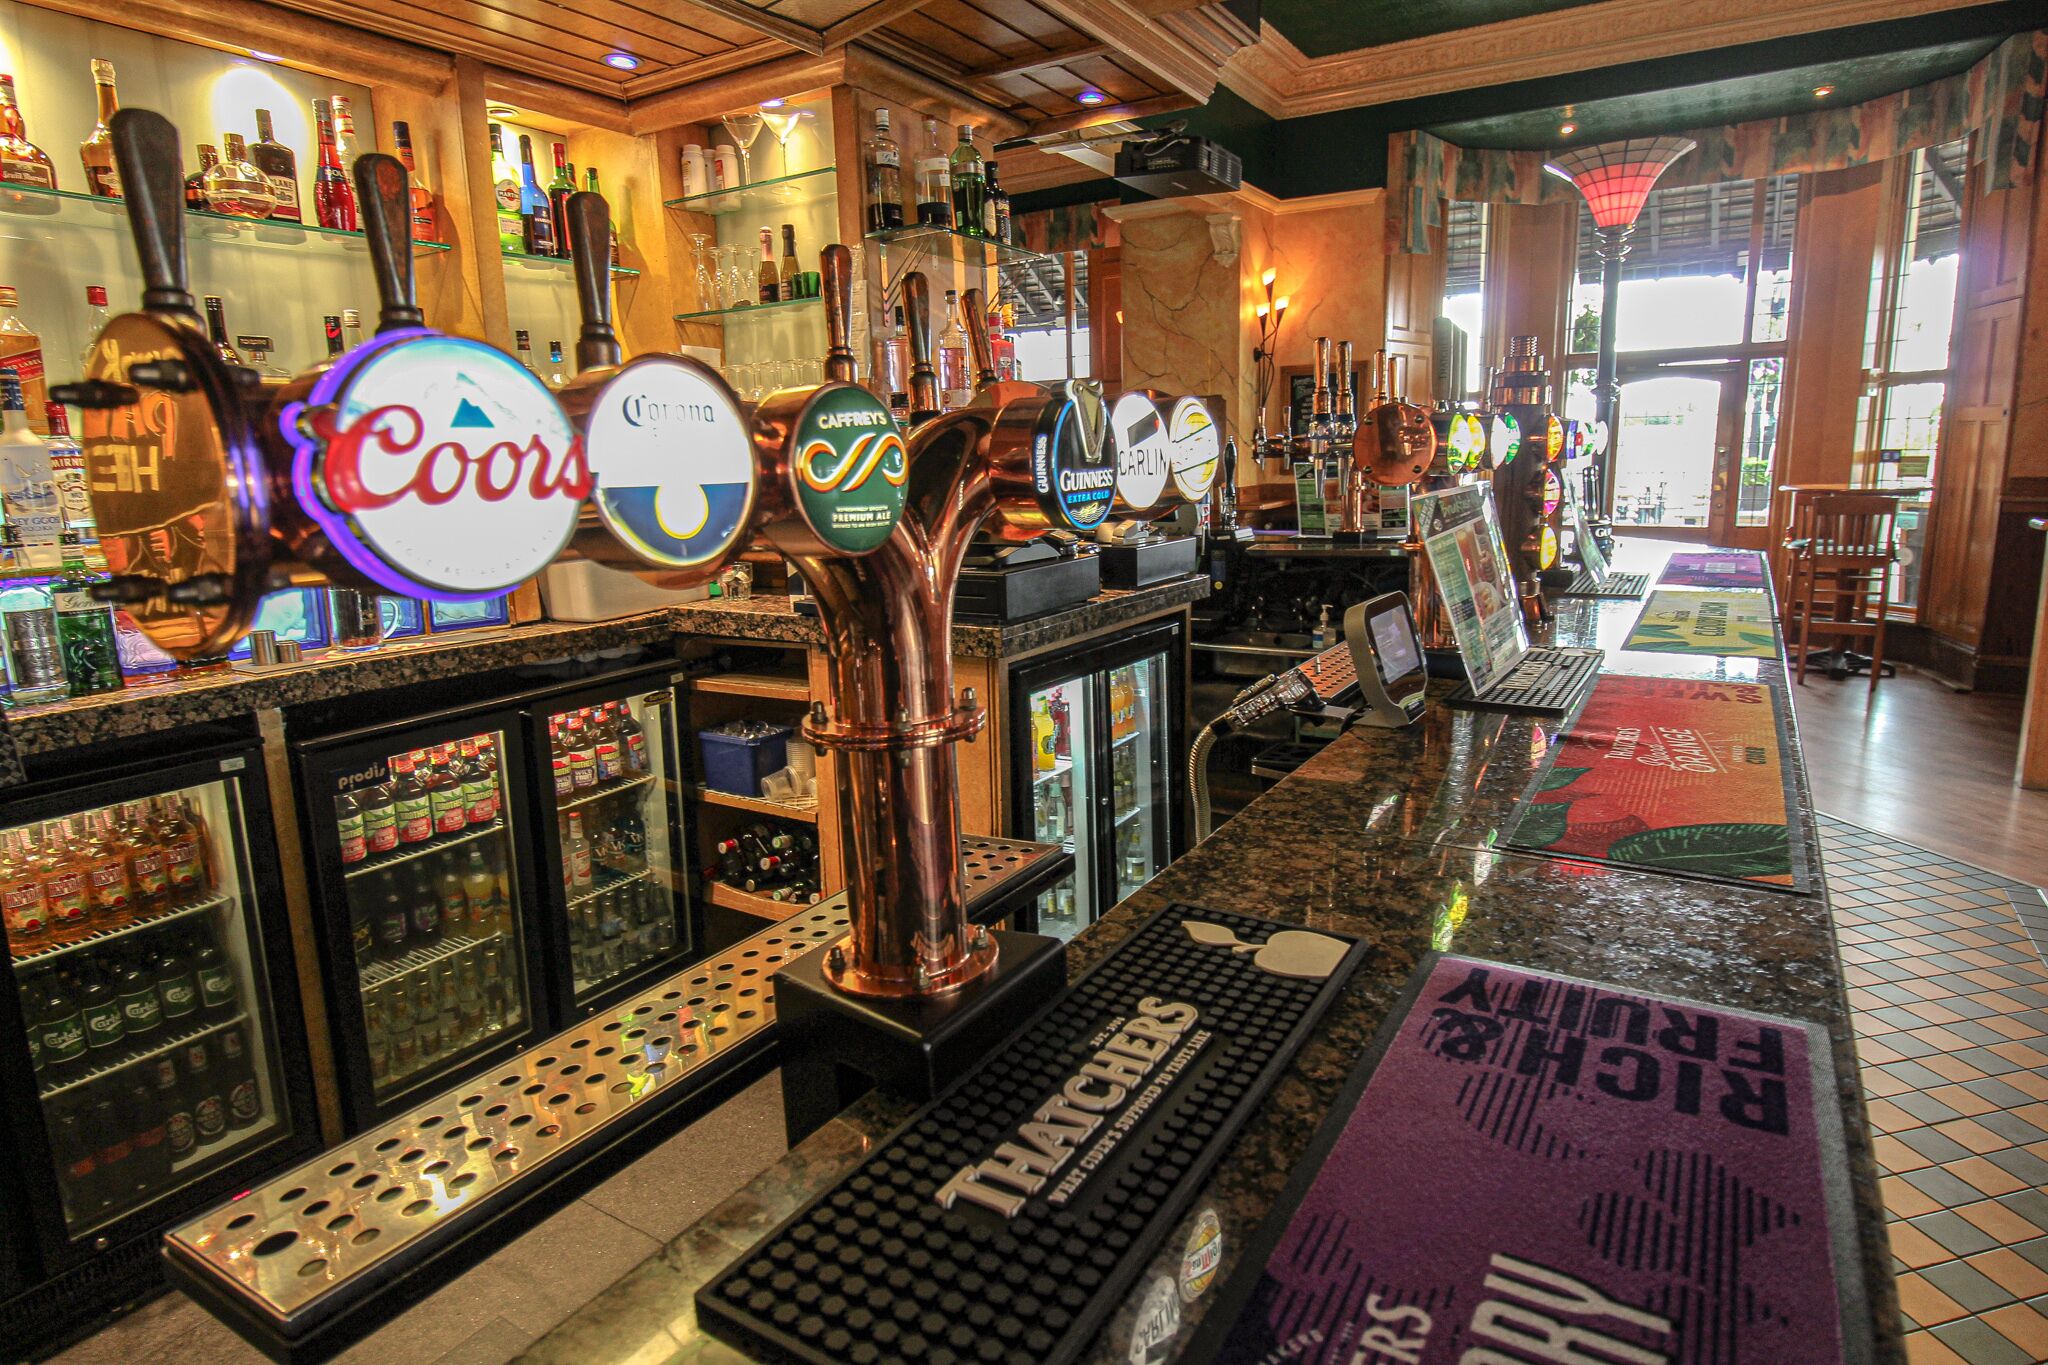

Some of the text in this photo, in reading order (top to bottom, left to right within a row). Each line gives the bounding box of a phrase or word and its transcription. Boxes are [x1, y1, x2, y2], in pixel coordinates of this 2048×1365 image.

[622, 394, 716, 428] Corona
[311, 404, 592, 513] Coors
[1036, 434, 1049, 494] GUINNESS
[1060, 469, 1114, 492] GUINNESS
[832, 510, 892, 523] PREMIUM ALE
[1067, 489, 1111, 504] EXTRA COLD
[1604, 726, 1641, 760] THATCHERS
[1658, 726, 1717, 773] ORANGE
[337, 762, 386, 791] prodis
[1437, 967, 1787, 1076] FRUITY
[1430, 1007, 1791, 1137] RICH &
[934, 996, 1199, 1218] THATCHERS
[1047, 1029, 1213, 1203] WHAT CIDER'S SUPPOSED TO TASTE LIKE
